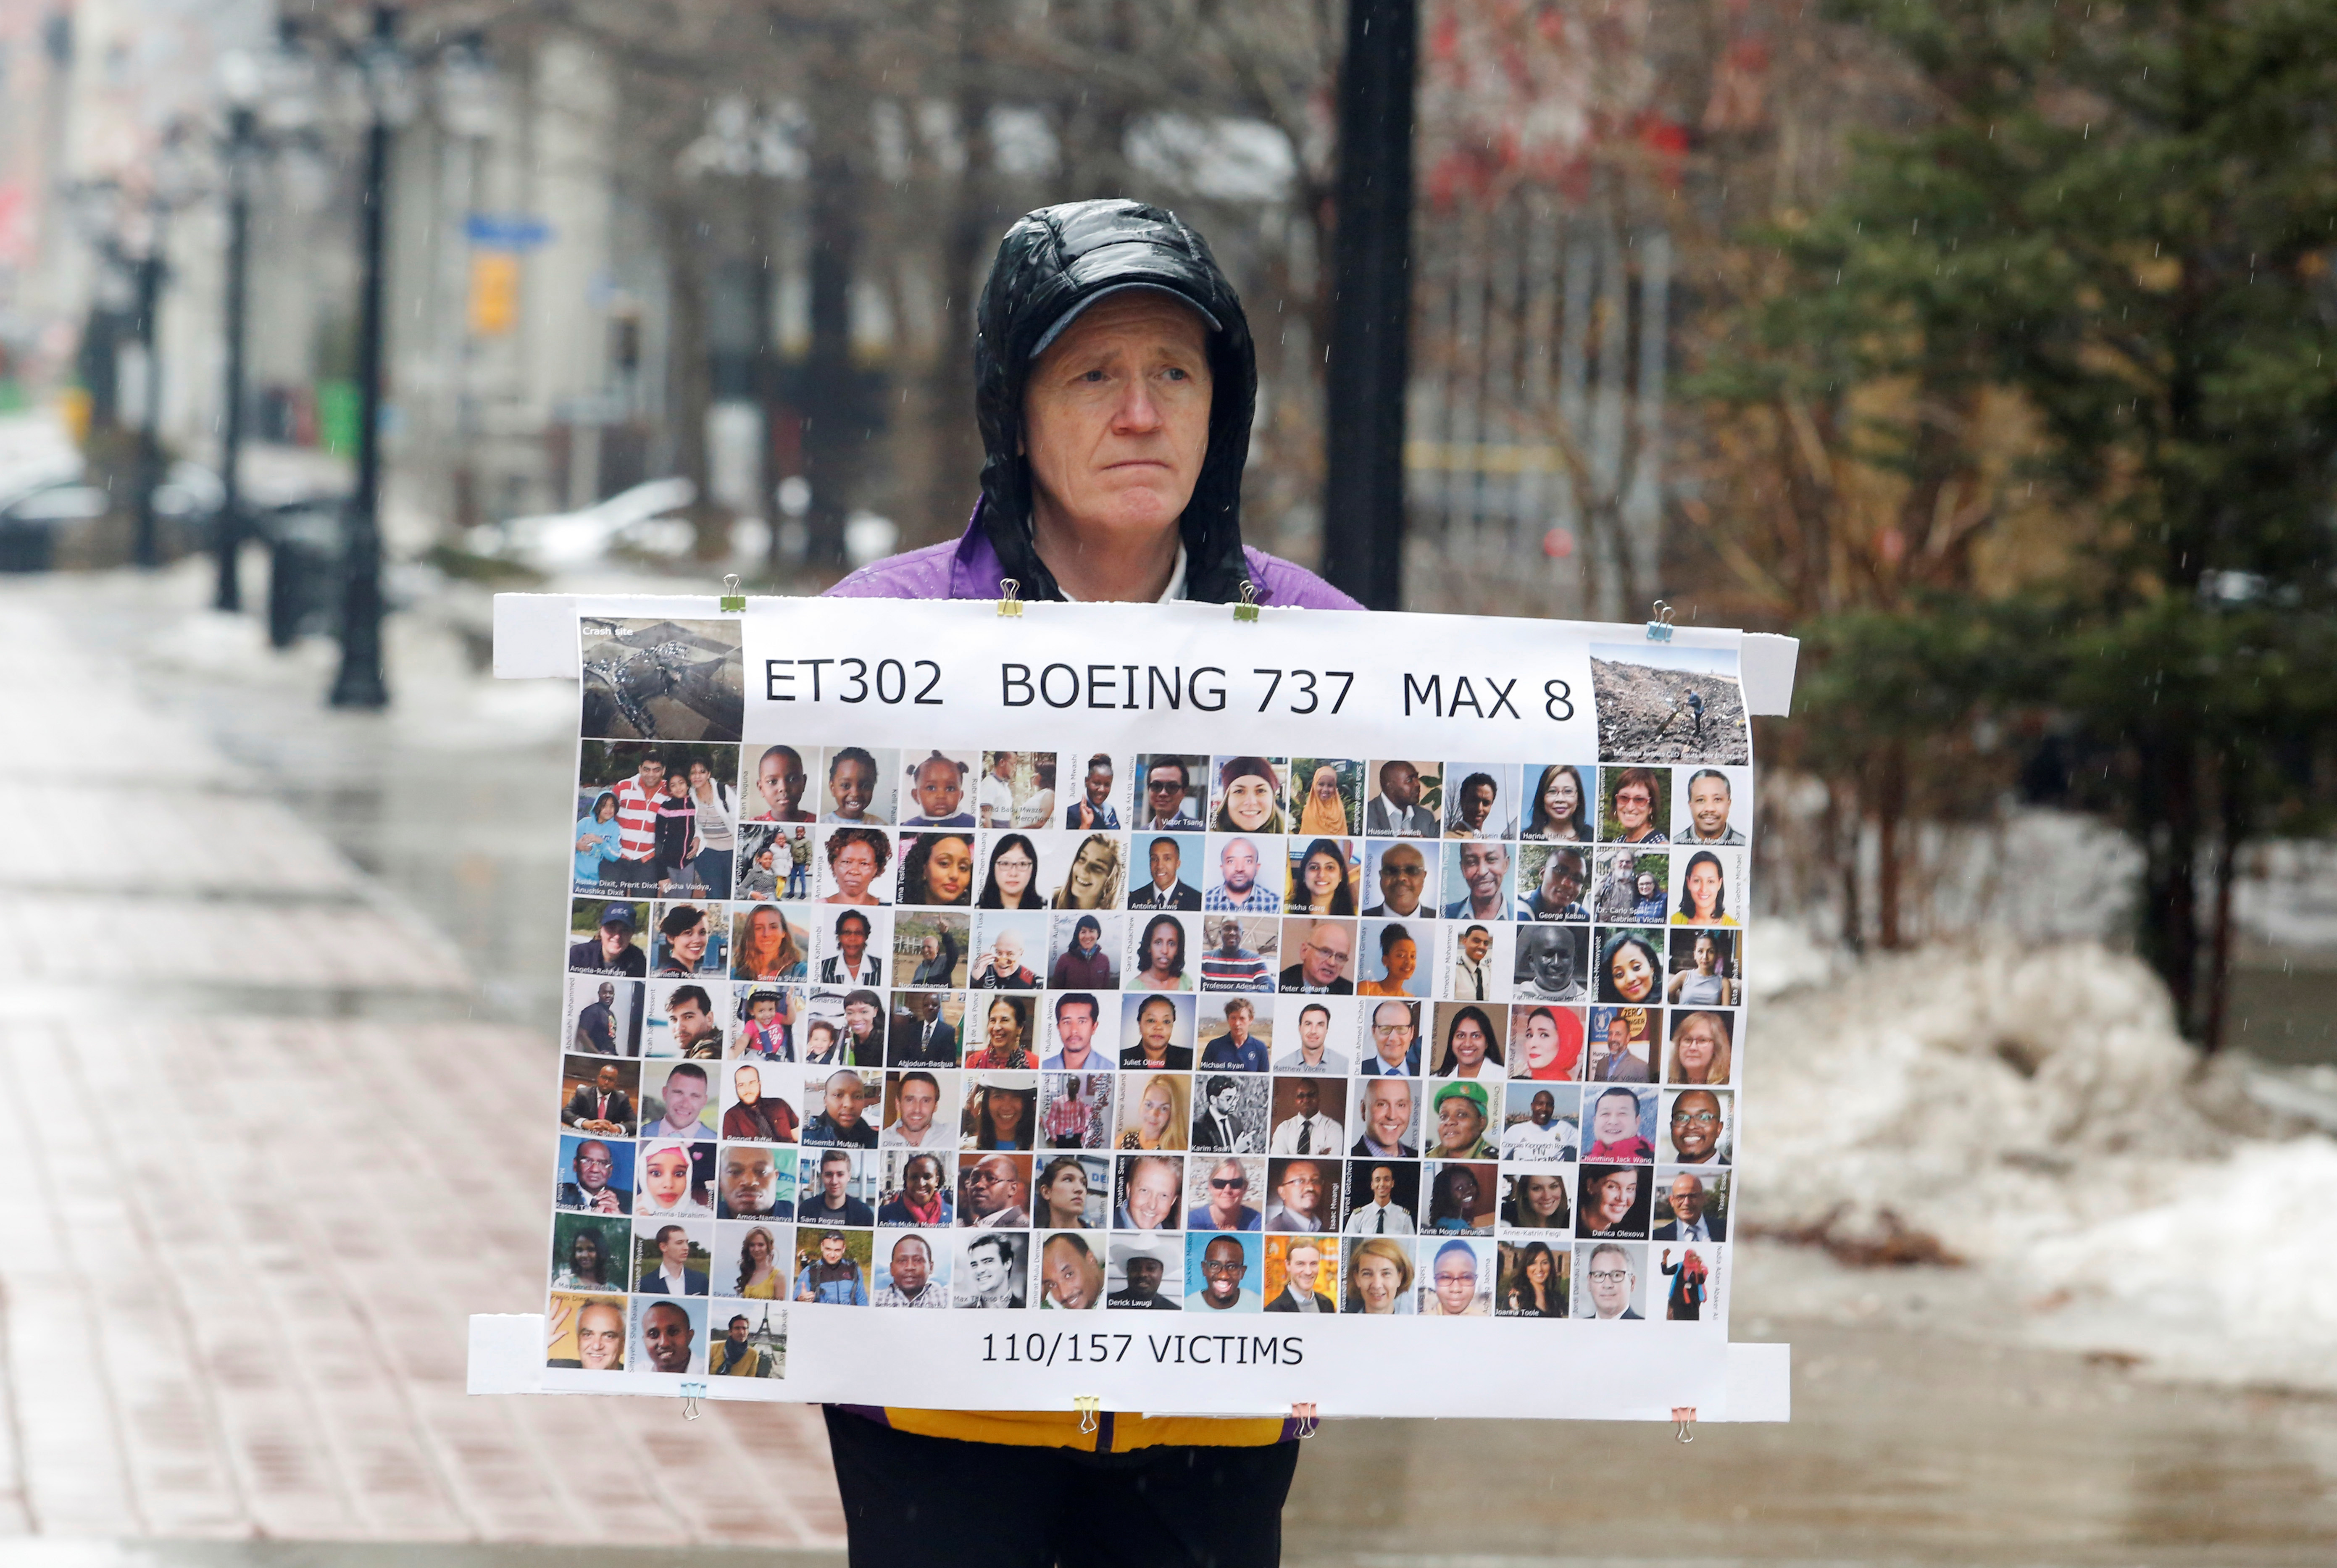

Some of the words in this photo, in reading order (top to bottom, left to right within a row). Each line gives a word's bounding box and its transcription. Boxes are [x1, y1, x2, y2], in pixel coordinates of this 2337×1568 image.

[583, 627, 611, 635] Crash
[766, 658, 943, 705] ET302
[1002, 663, 1226, 712] BOEING
[1253, 669, 1354, 714] 737
[1404, 673, 1521, 719] MAX
[1545, 679, 1574, 721] 8
[1599, 801, 1604, 810] De
[1184, 819, 1203, 828] Tsang
[816, 856, 824, 883] Karanja
[978, 832, 987, 895] Zhen-Zhen-Huang
[574, 886, 605, 895] Anushka
[607, 888, 624, 896] Dixit
[598, 880, 618, 889] Dixit,
[1308, 904, 1325, 913] Garg
[1539, 911, 1563, 920] George
[1445, 925, 1453, 963] Mohammed
[813, 962, 821, 982] Agnes
[567, 978, 575, 1017] Mohammed
[1116, 1176, 1124, 1208] Jonathan
[1330, 1183, 1339, 1209] Mwangi
[818, 1217, 845, 1226] Pegram
[1592, 1229, 1615, 1238] Danica
[982, 1332, 1132, 1367] 110/157
[1148, 1334, 1304, 1365] VICTIMS
